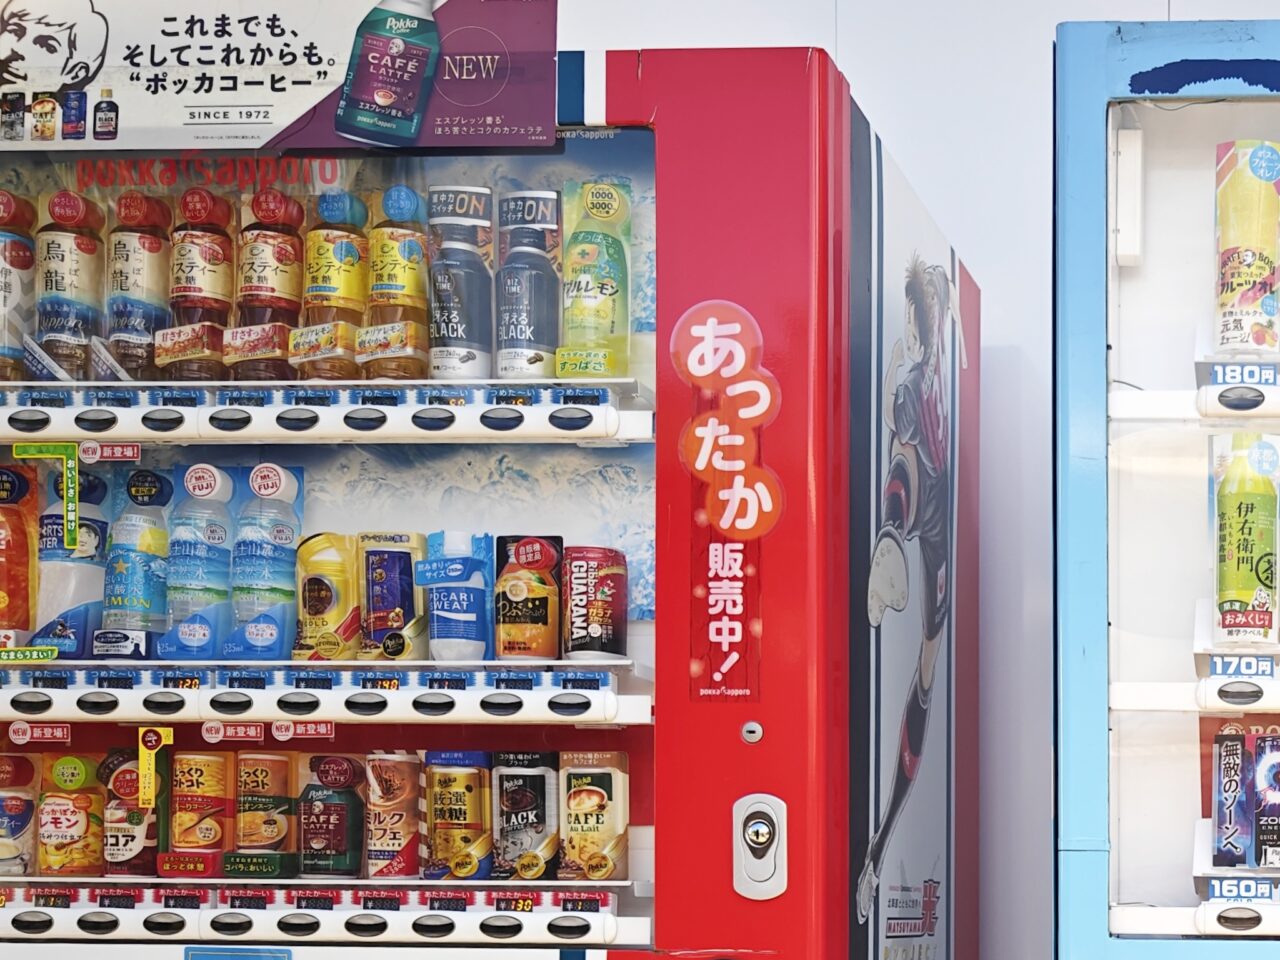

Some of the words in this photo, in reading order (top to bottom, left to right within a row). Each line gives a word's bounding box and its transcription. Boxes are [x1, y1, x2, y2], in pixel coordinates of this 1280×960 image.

[160, 14, 299, 38] これまでも、
[386, 17, 418, 30] Pokka
[122, 43, 336, 67] そしてこれからも。
[368, 53, 420, 73] CAFÉ
[369, 66, 411, 81] LATTE
[443, 56, 500, 79] NEW
[189, 111, 230, 119] SINCE
[239, 110, 270, 119] 1972
[455, 193, 485, 216] ON
[524, 200, 552, 221] ON
[430, 322, 466, 339] BLACK
[1221, 320, 1244, 331] 元気
[1215, 365, 1275, 384] 180円
[687, 317, 773, 529] あったか
[103, 446, 138, 457] 新登場!
[1236, 501, 1256, 573] 伊右衛門
[587, 561, 598, 601] Ribbon
[429, 592, 474, 602] POCARI
[570, 562, 588, 640] GUARANA
[429, 602, 469, 611] SWEAT
[708, 542, 744, 683] 販売中!
[1213, 657, 1271, 675] 170円
[33, 727, 68, 738] 新登場!
[226, 726, 261, 737] 新登場!
[296, 724, 332, 735] 新登場!
[1222, 743, 1242, 854] 無敵のゾーンへ。
[1210, 880, 1271, 898] 160円
[887, 918, 923, 934] MATSUYAMA
